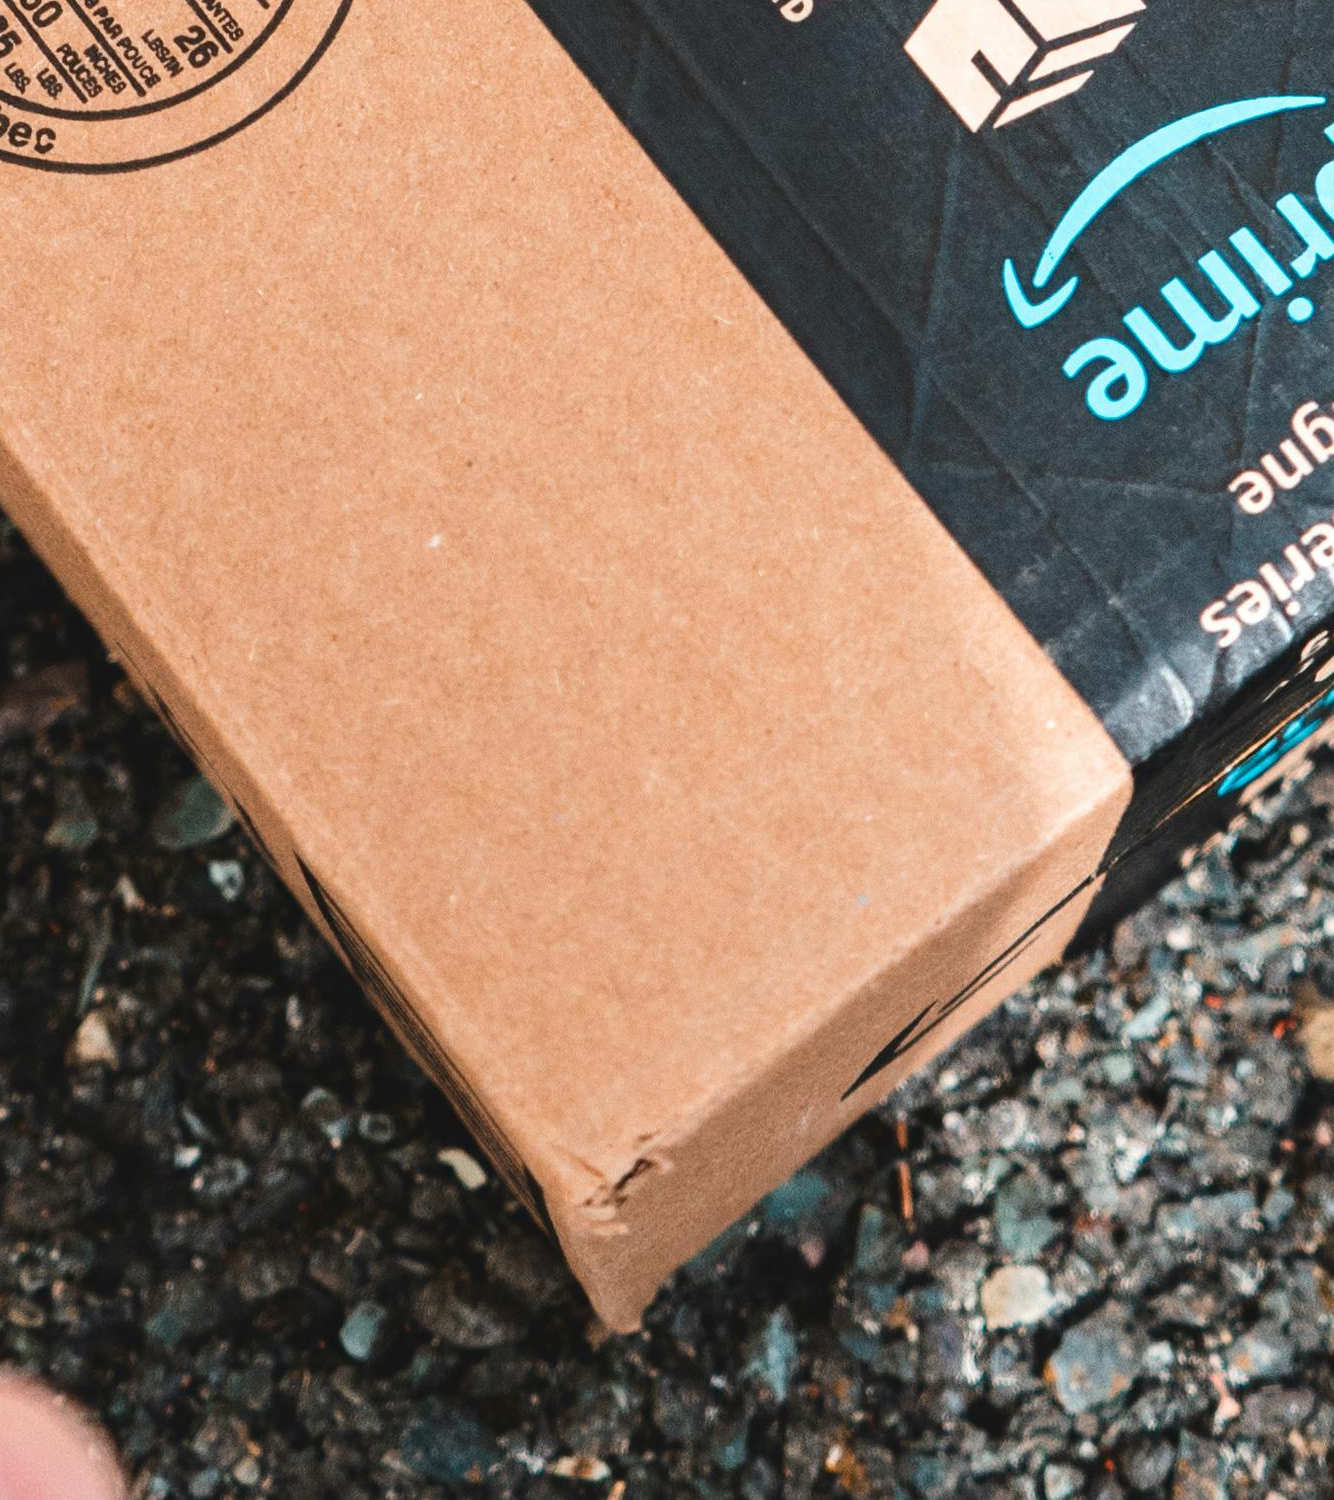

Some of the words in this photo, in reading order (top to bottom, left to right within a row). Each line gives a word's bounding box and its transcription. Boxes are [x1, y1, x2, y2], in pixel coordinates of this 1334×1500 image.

[56, 43, 103, 97] POUCES
[93, 7, 122, 39] PAR
[116, 37, 161, 88] POUCE
[173, 25, 219, 68] 26
